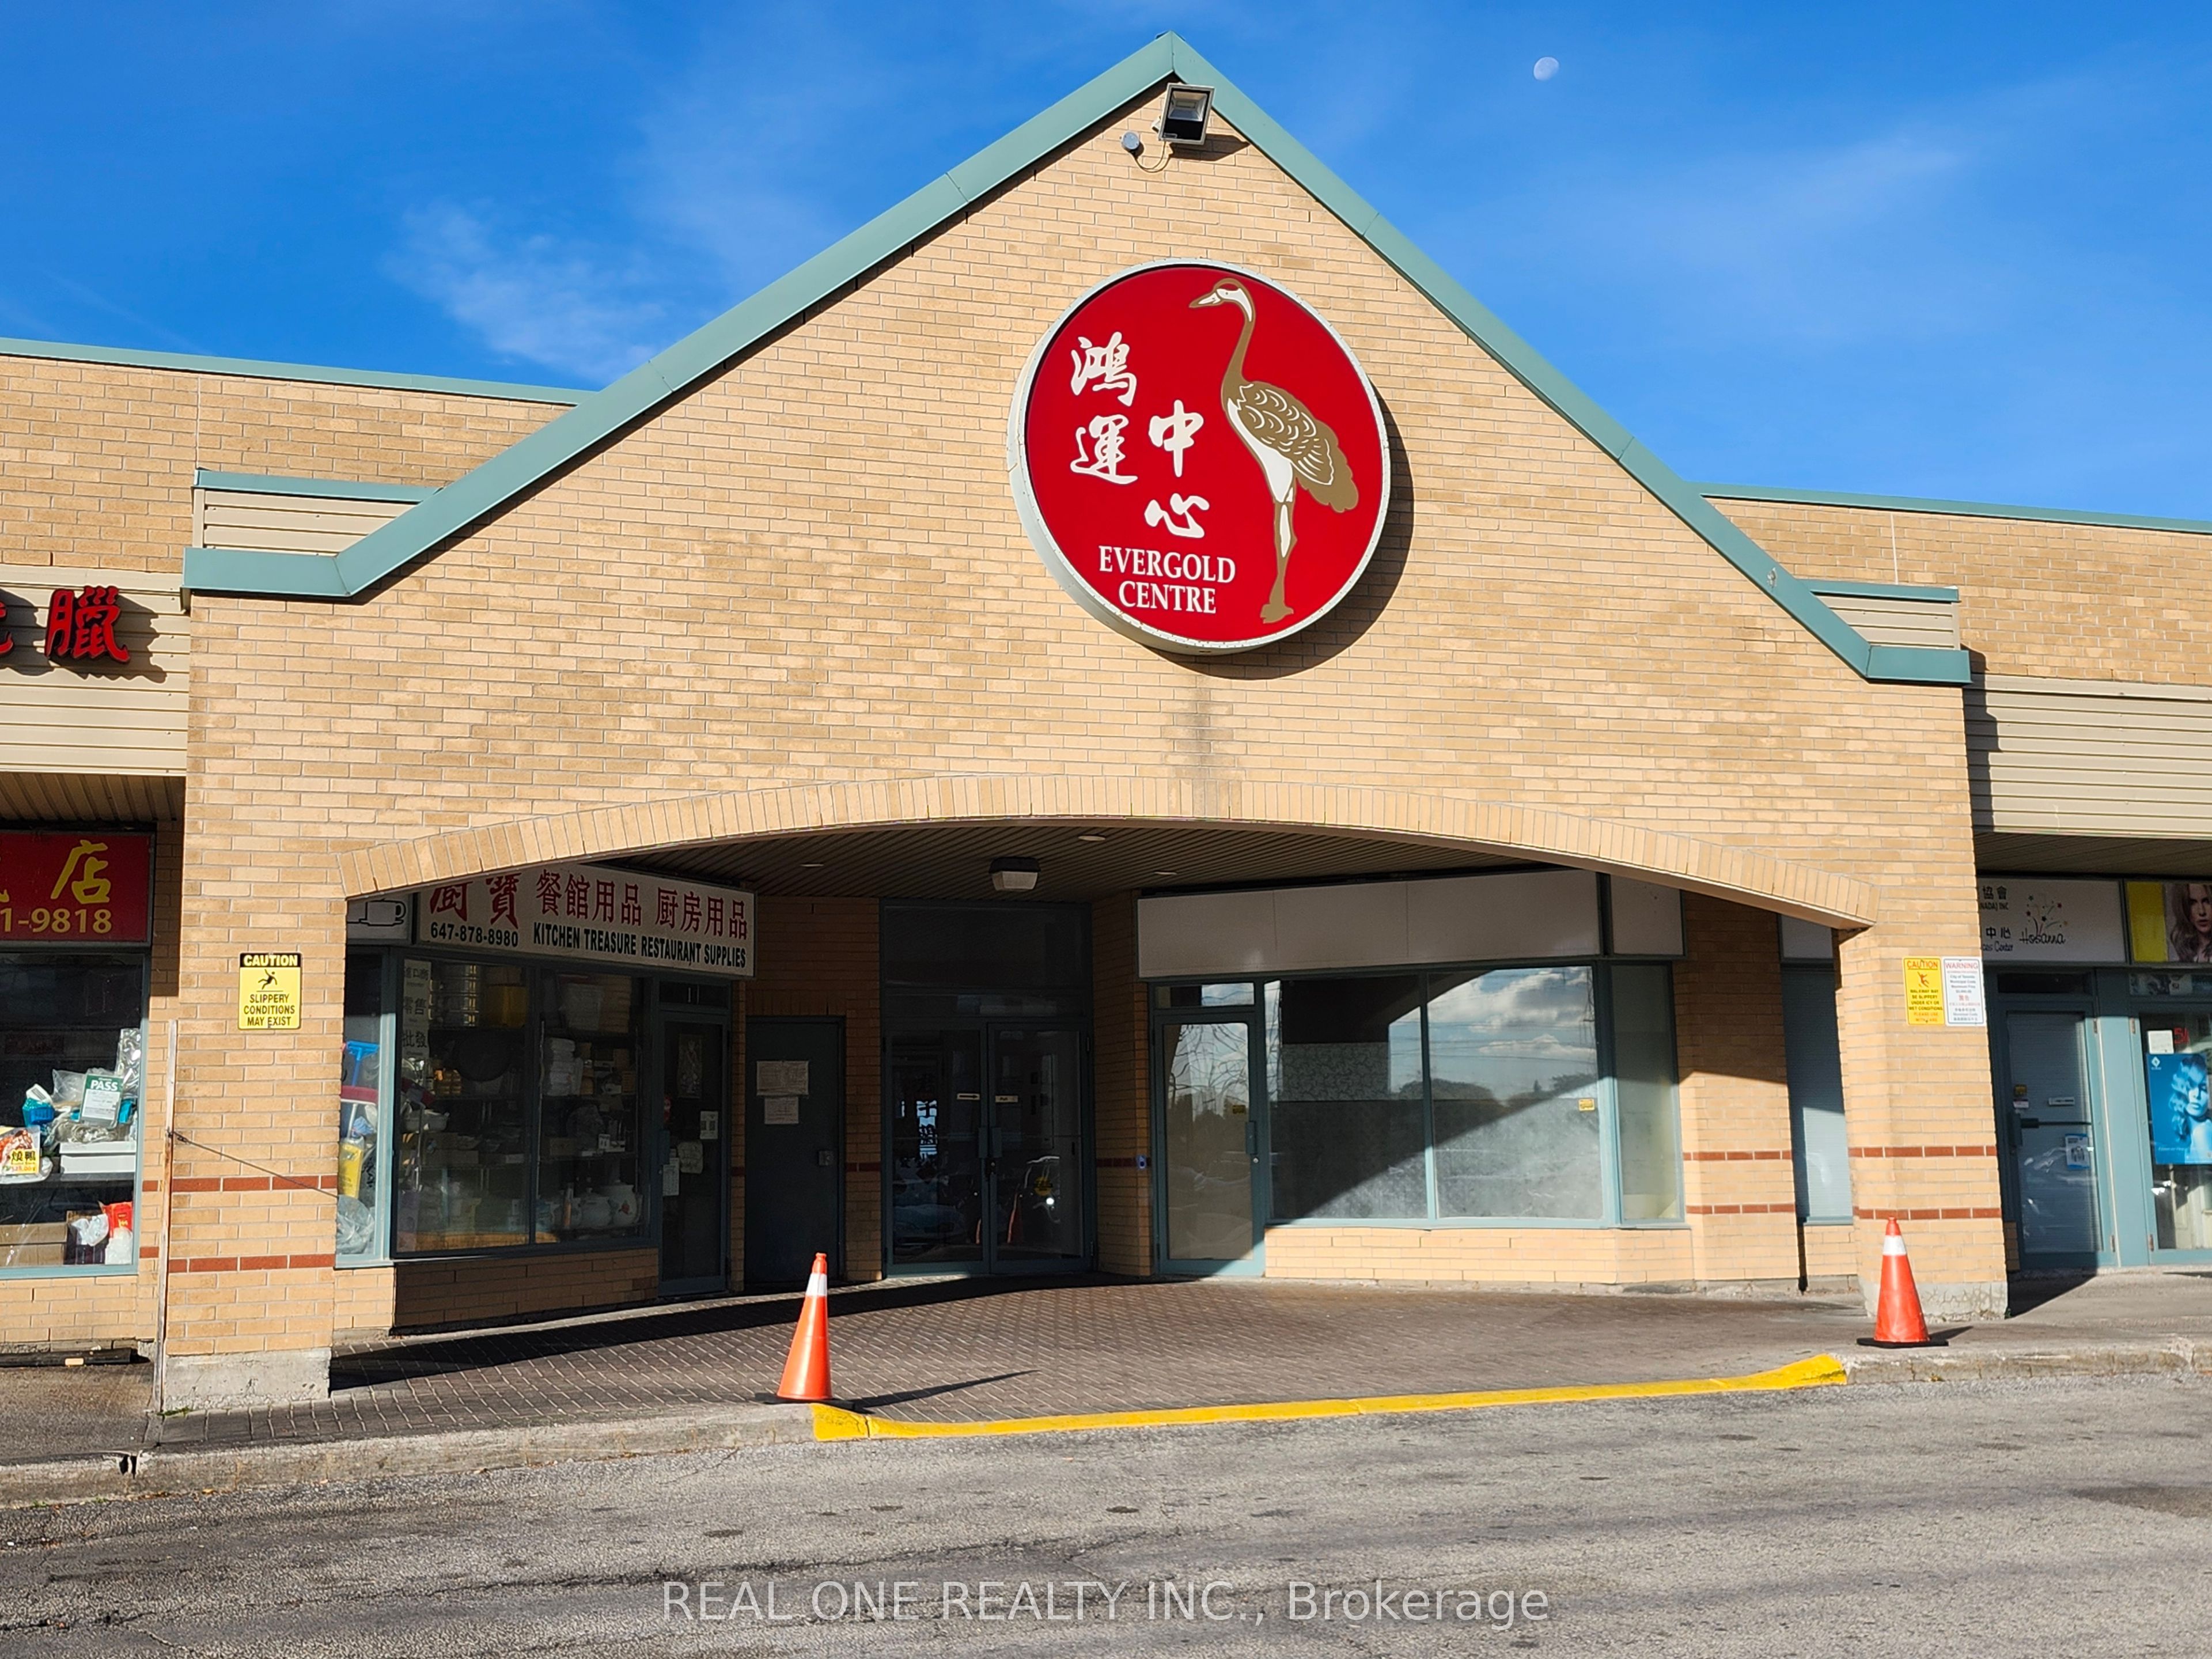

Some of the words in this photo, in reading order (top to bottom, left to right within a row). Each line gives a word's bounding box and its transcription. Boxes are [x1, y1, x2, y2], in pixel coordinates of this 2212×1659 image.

[1070, 331, 1138, 484] 鴻運
[1144, 400, 1210, 539] 中心
[1098, 545, 1236, 584] EVERGOLD
[1118, 580, 1217, 614] CENTRE
[0, 907, 112, 934] 1-9818
[431, 922, 519, 948] 647-878-8980
[1986, 926, 2011, 939] 中心
[533, 922, 579, 949] KITCHEN
[584, 929, 637, 956] TREASURE
[641, 935, 702, 963] RESTAURANT
[704, 945, 746, 968] SUPPLIES
[243, 955, 298, 967] CAUTION
[1907, 960, 1938, 968] CAUTION
[249, 994, 289, 1003] SLIPPERY
[243, 1005, 296, 1014] CONDITIONS
[247, 1017, 264, 1026] MAY
[267, 1016, 291, 1026] EXIST
[90, 1080, 118, 1092] PASS
